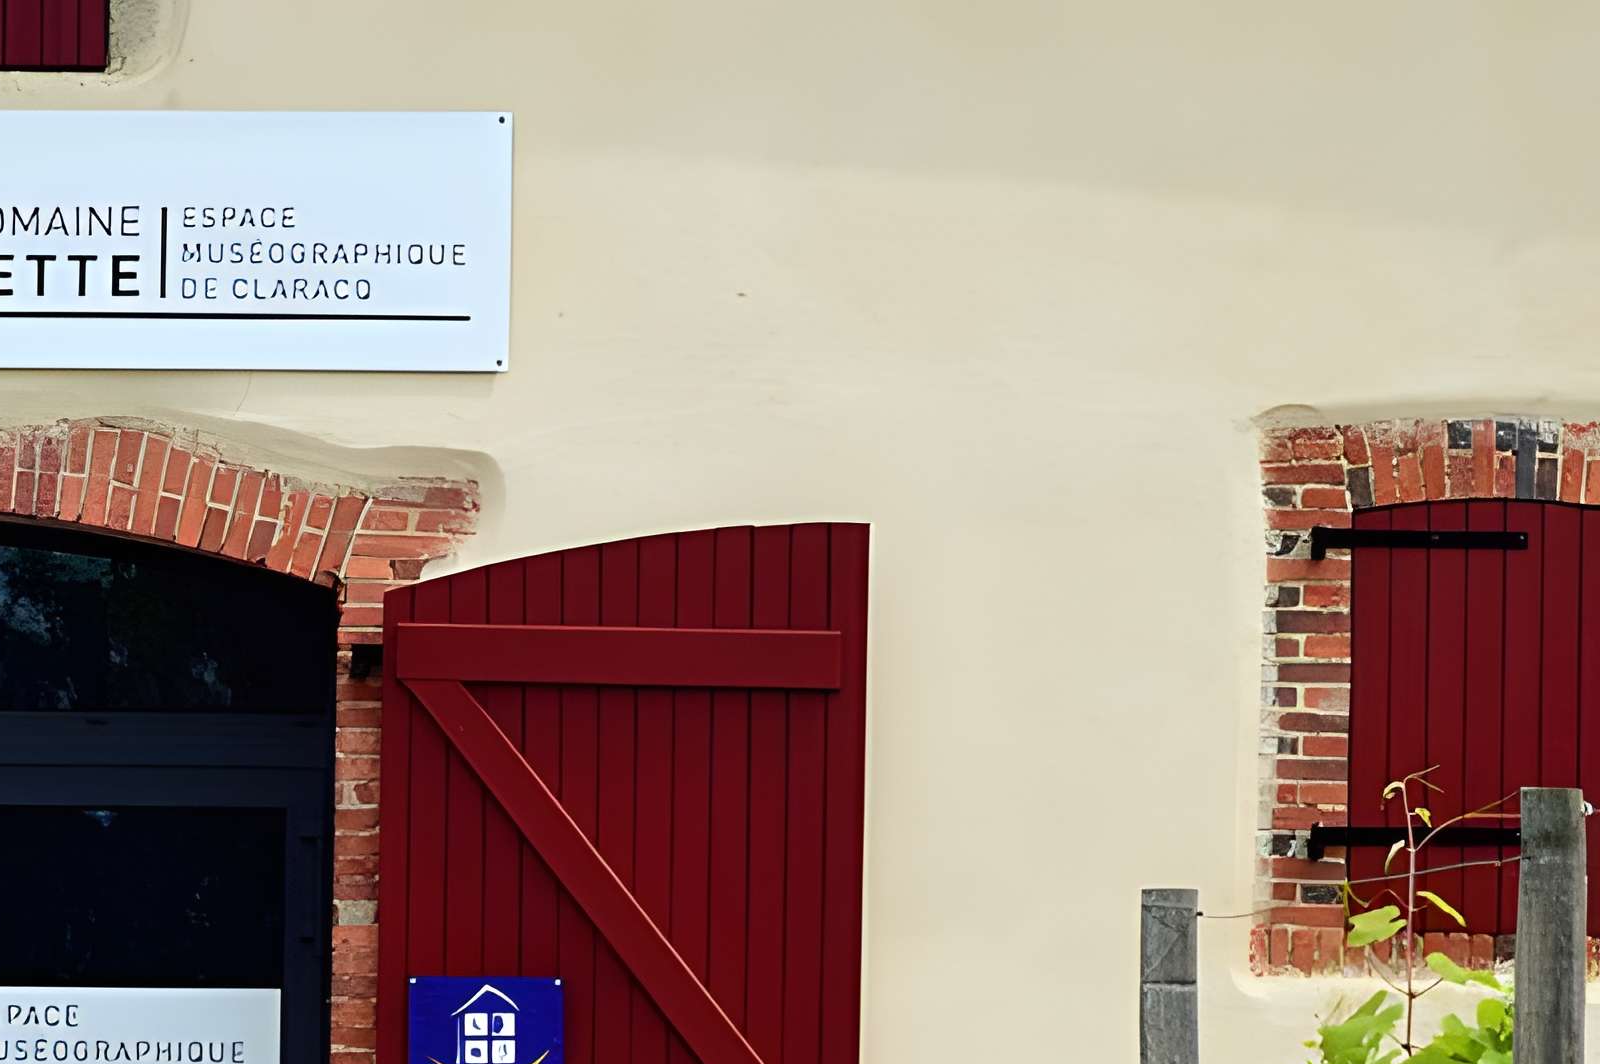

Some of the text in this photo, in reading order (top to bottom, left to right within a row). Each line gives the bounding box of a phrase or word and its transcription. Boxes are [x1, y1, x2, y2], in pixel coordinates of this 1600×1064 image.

[182, 206, 296, 229] ESPACE
[181, 238, 467, 266] MUSÉOGRAPHIQUE
[181, 277, 218, 300] DE
